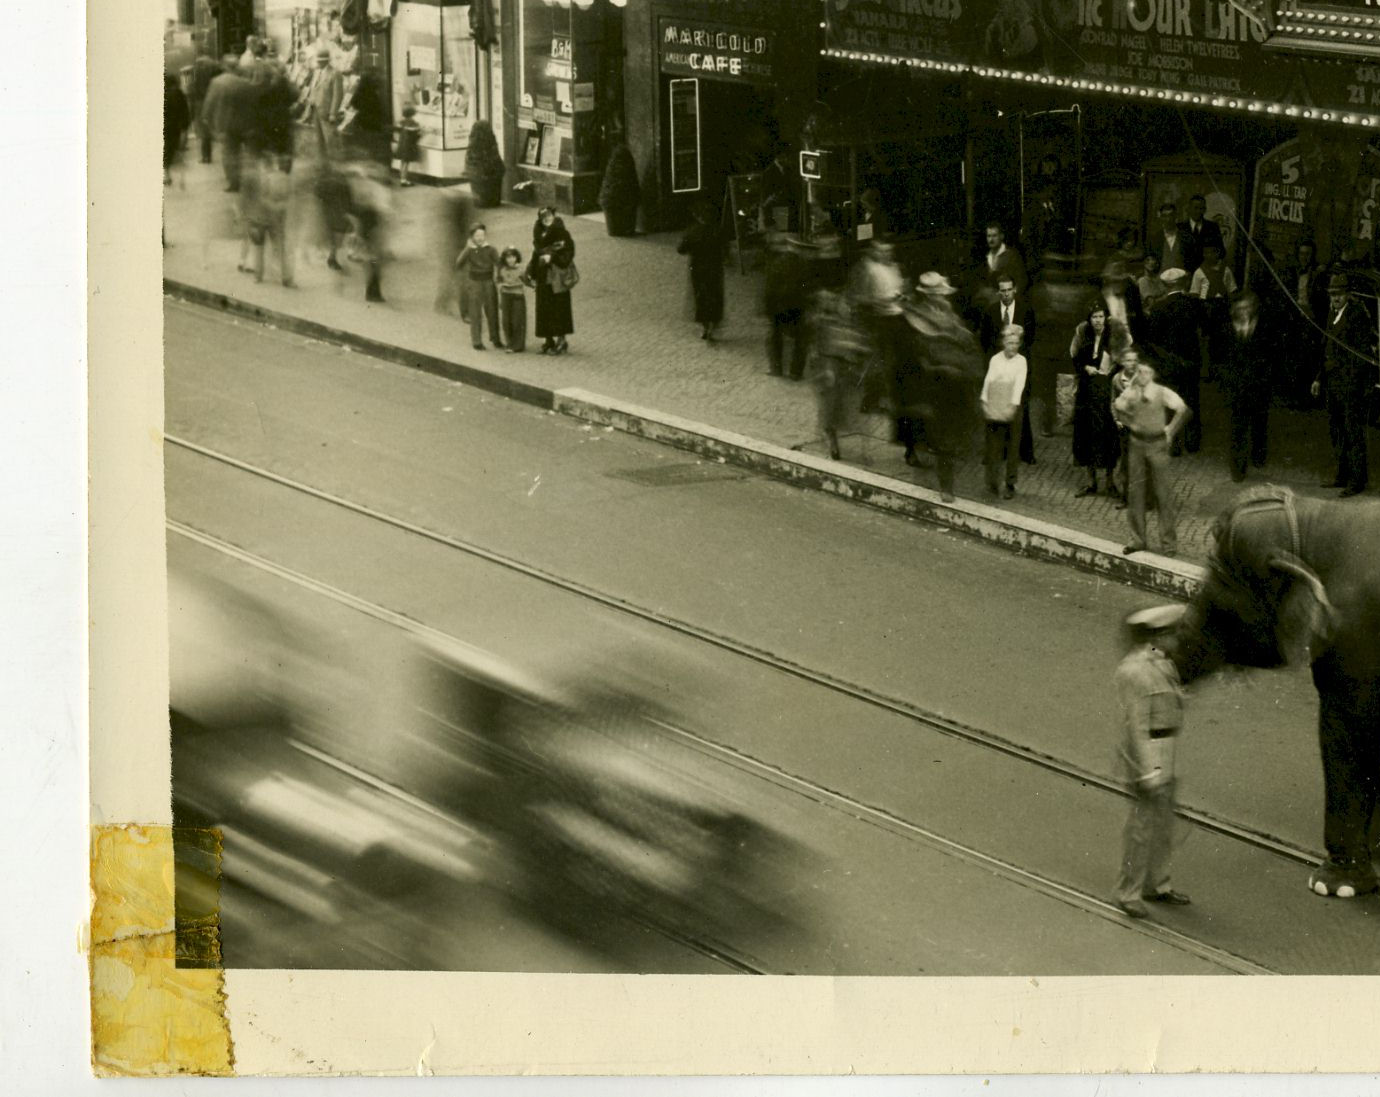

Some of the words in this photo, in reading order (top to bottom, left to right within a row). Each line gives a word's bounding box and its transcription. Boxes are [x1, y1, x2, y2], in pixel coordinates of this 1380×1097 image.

[664, 26, 766, 54] MARIGOLD
[1160, 37, 1183, 53] HELEN
[1187, 40, 1240, 60] TWELVETREES
[689, 53, 741, 75] CAFE
[1347, 85, 1365, 103] 21
[1281, 155, 1301, 184] 5
